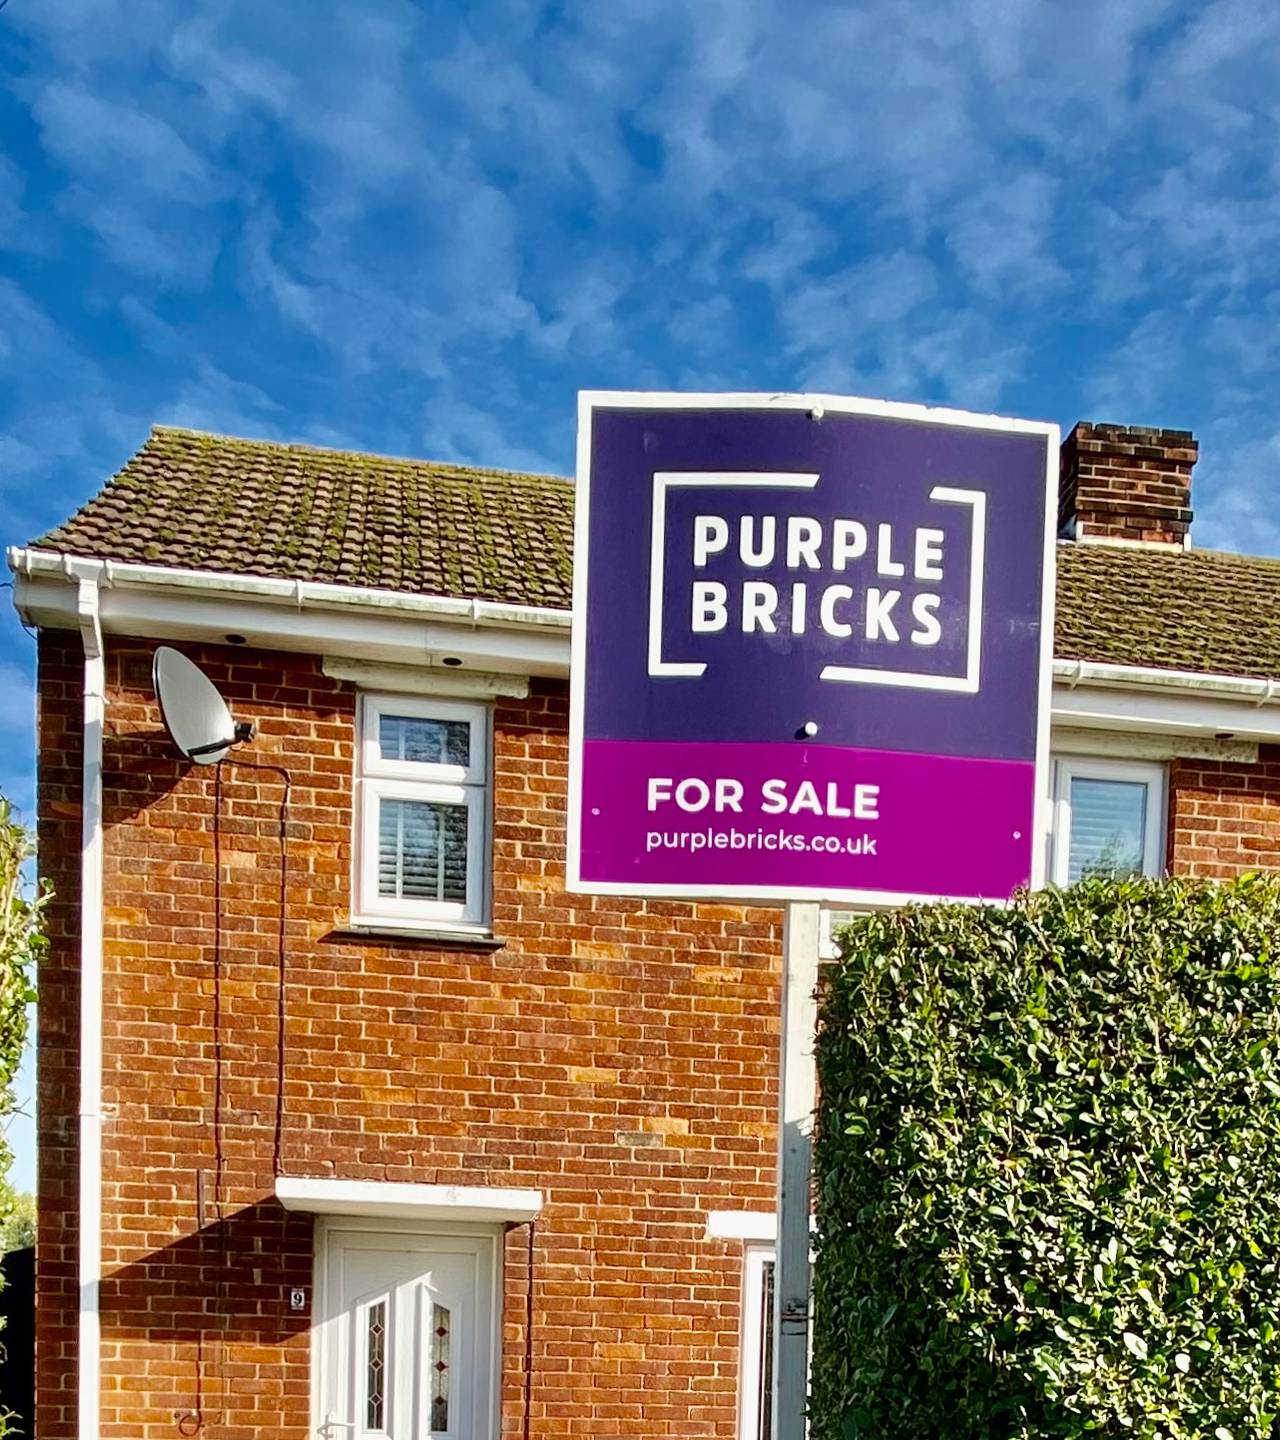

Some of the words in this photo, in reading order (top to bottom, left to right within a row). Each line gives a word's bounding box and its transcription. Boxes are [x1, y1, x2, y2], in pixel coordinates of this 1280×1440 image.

[693, 515, 945, 581] PURPLE
[691, 581, 942, 646] BRICKS
[647, 777, 744, 814] FOR
[760, 779, 880, 820] SALE
[646, 827, 878, 855] purplebricks.co.uk
[293, 1292, 303, 1306] 9
